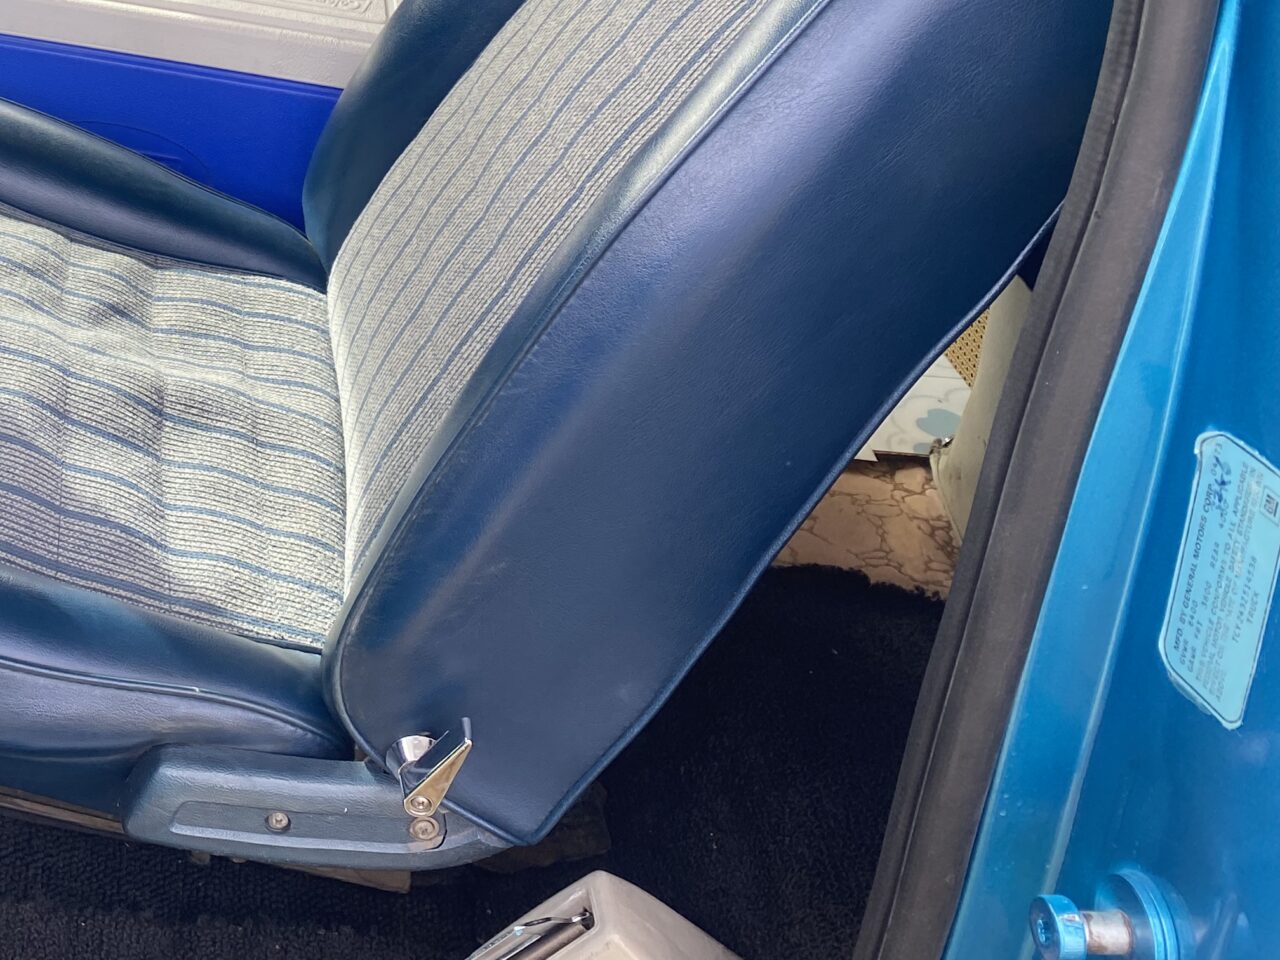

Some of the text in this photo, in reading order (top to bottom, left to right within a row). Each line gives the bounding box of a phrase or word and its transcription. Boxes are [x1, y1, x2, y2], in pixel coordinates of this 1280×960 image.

[1232, 460, 1248, 517] APPLICABLE
[1264, 492, 1275, 514] GM
[1193, 515, 1207, 560] MOTORS
[1227, 519, 1235, 540] ALL
[1224, 541, 1231, 555] TO
[1182, 562, 1197, 608] GENERAL
[1179, 609, 1187, 624] BY
[1246, 588, 1260, 624] TRUCK
